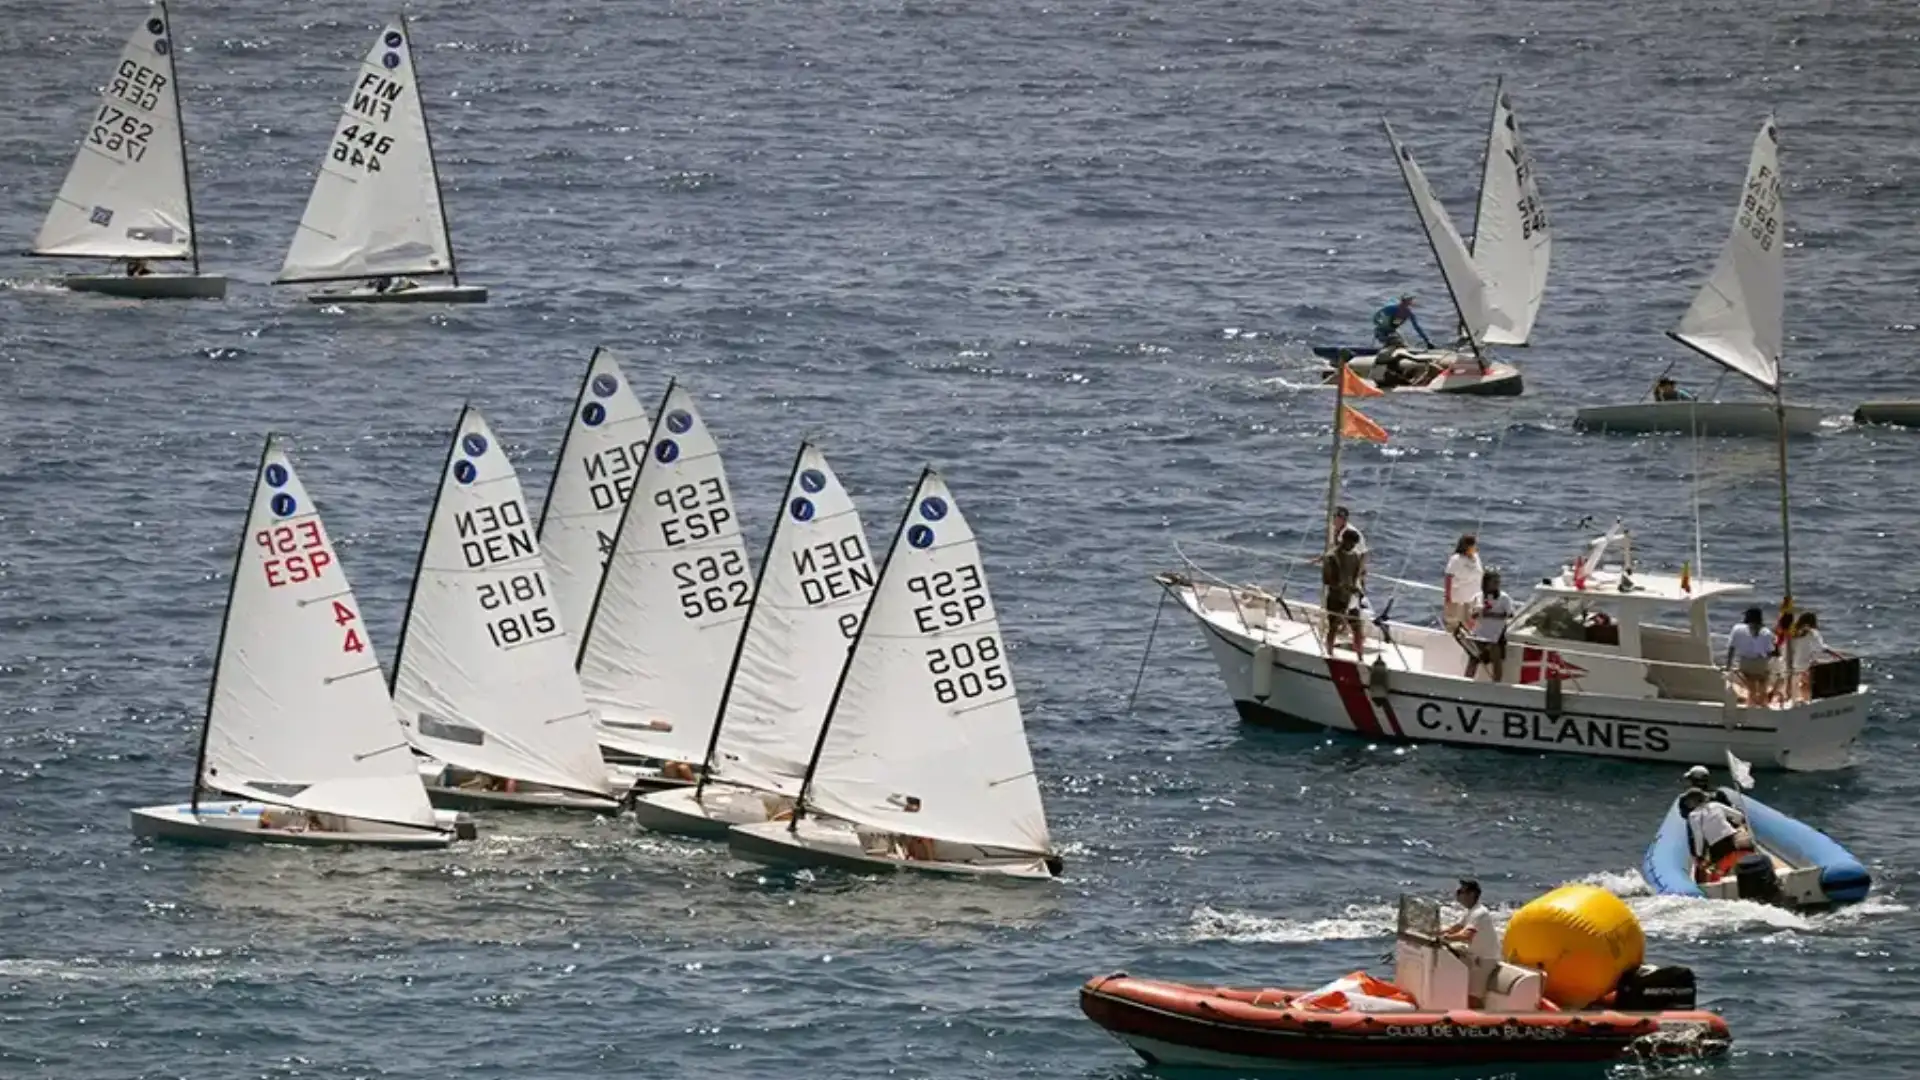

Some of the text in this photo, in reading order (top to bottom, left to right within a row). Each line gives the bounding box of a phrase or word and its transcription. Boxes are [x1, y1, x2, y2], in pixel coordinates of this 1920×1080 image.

[118, 60, 167, 93] GER
[359, 72, 403, 101] FIN
[97, 105, 154, 143] 1762
[342, 125, 395, 155] 446
[589, 476, 633, 511] DE
[660, 507, 731, 547] ESP
[461, 529, 534, 568] DEN
[263, 550, 331, 588] ESP
[800, 562, 875, 606] DEN
[680, 579, 751, 619] 562
[913, 594, 987, 633] ESP
[343, 628, 364, 653] 4
[486, 607, 556, 647] 1815
[934, 665, 1008, 704] 805
[1416, 702, 1670, 753] C.V. BLANES
[1385, 1024, 1429, 1038] CLUB
[1431, 1024, 1453, 1038] DE
[1456, 1024, 1500, 1038] VELA
